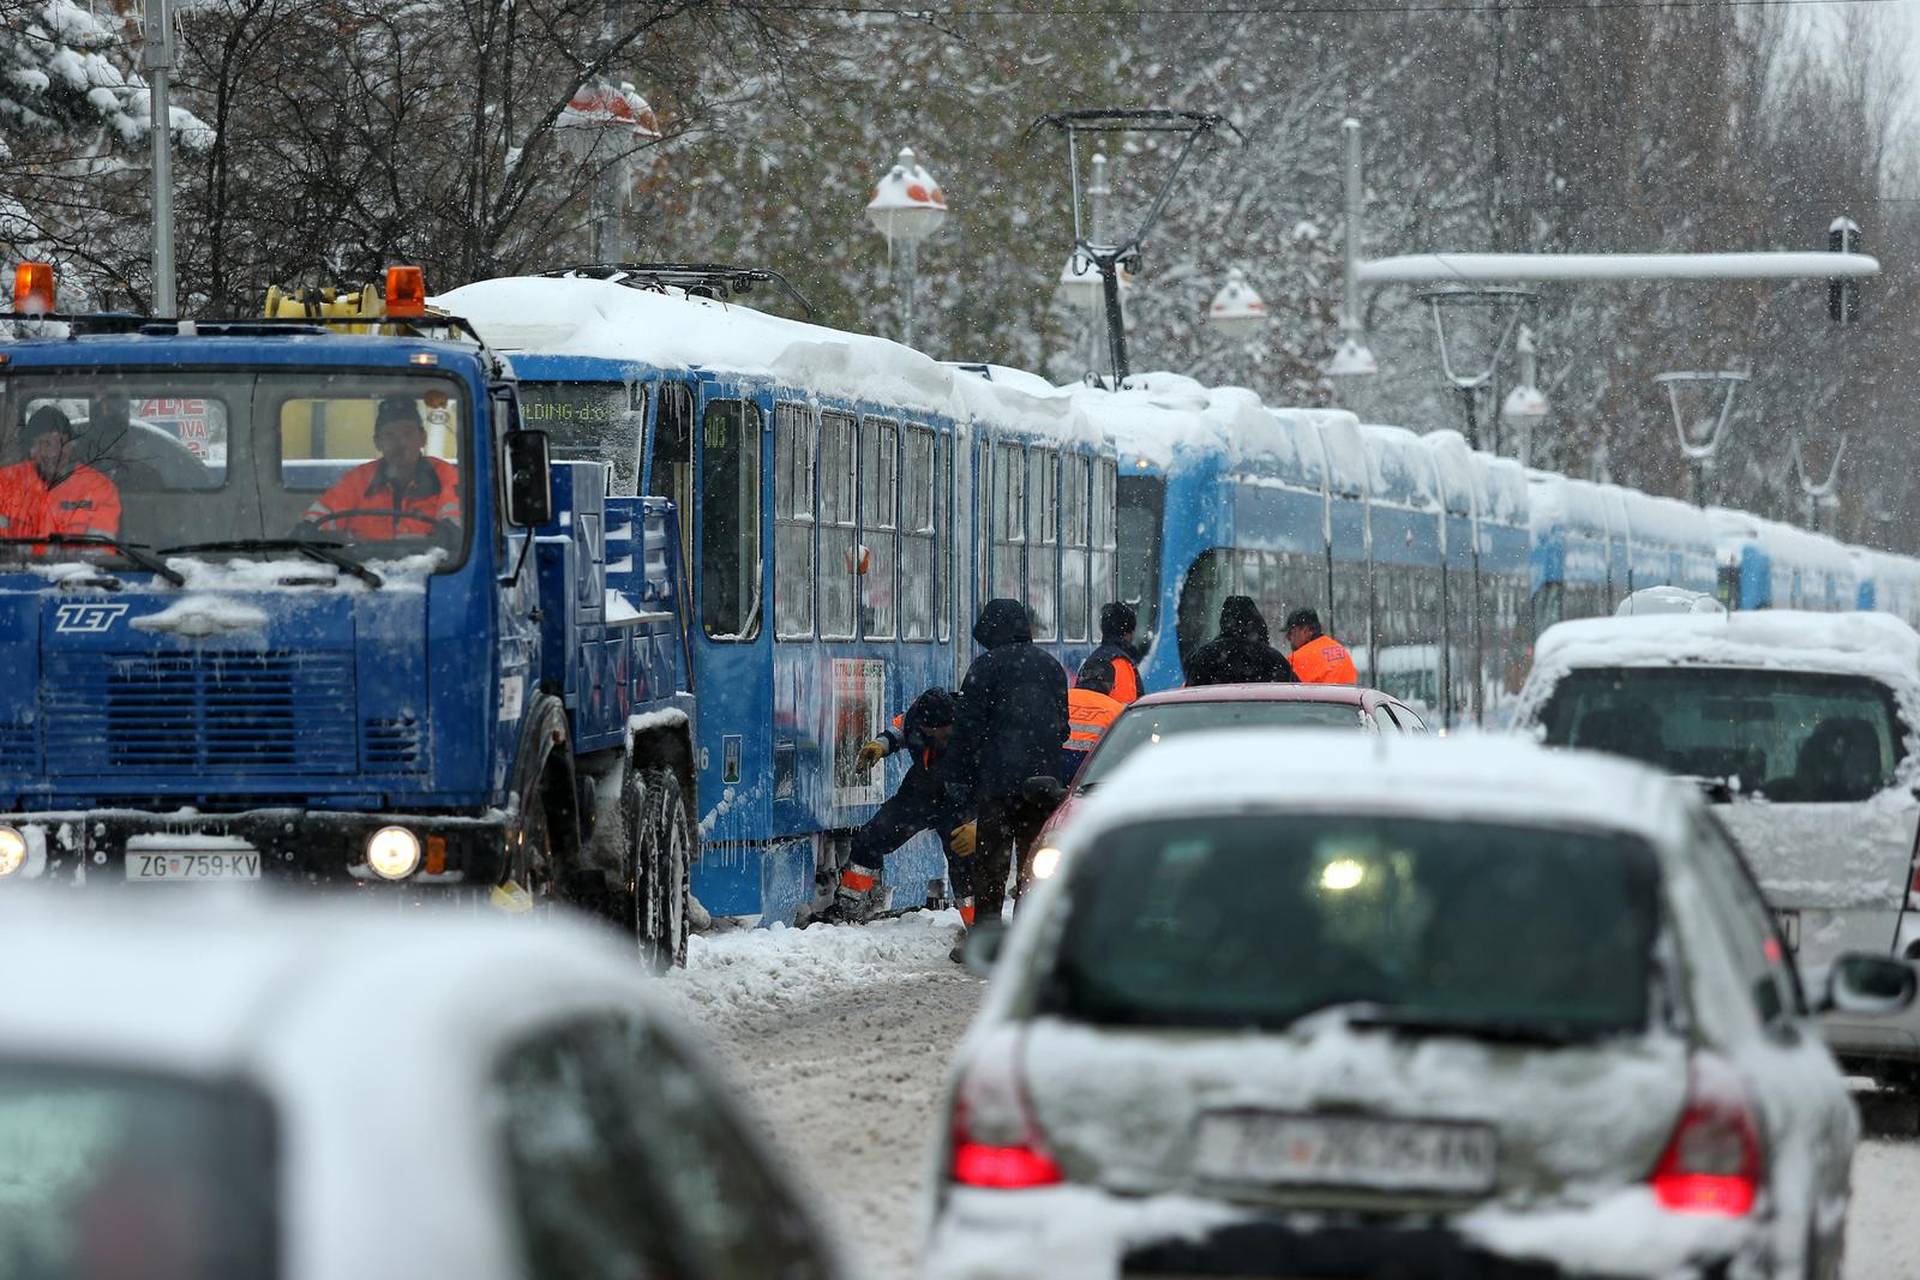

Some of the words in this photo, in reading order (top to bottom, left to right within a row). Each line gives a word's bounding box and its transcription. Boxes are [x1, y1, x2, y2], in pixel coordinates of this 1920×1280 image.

[56, 604, 129, 632] ZET
[139, 855, 167, 877] ZG
[183, 855, 258, 877] 759-KV
